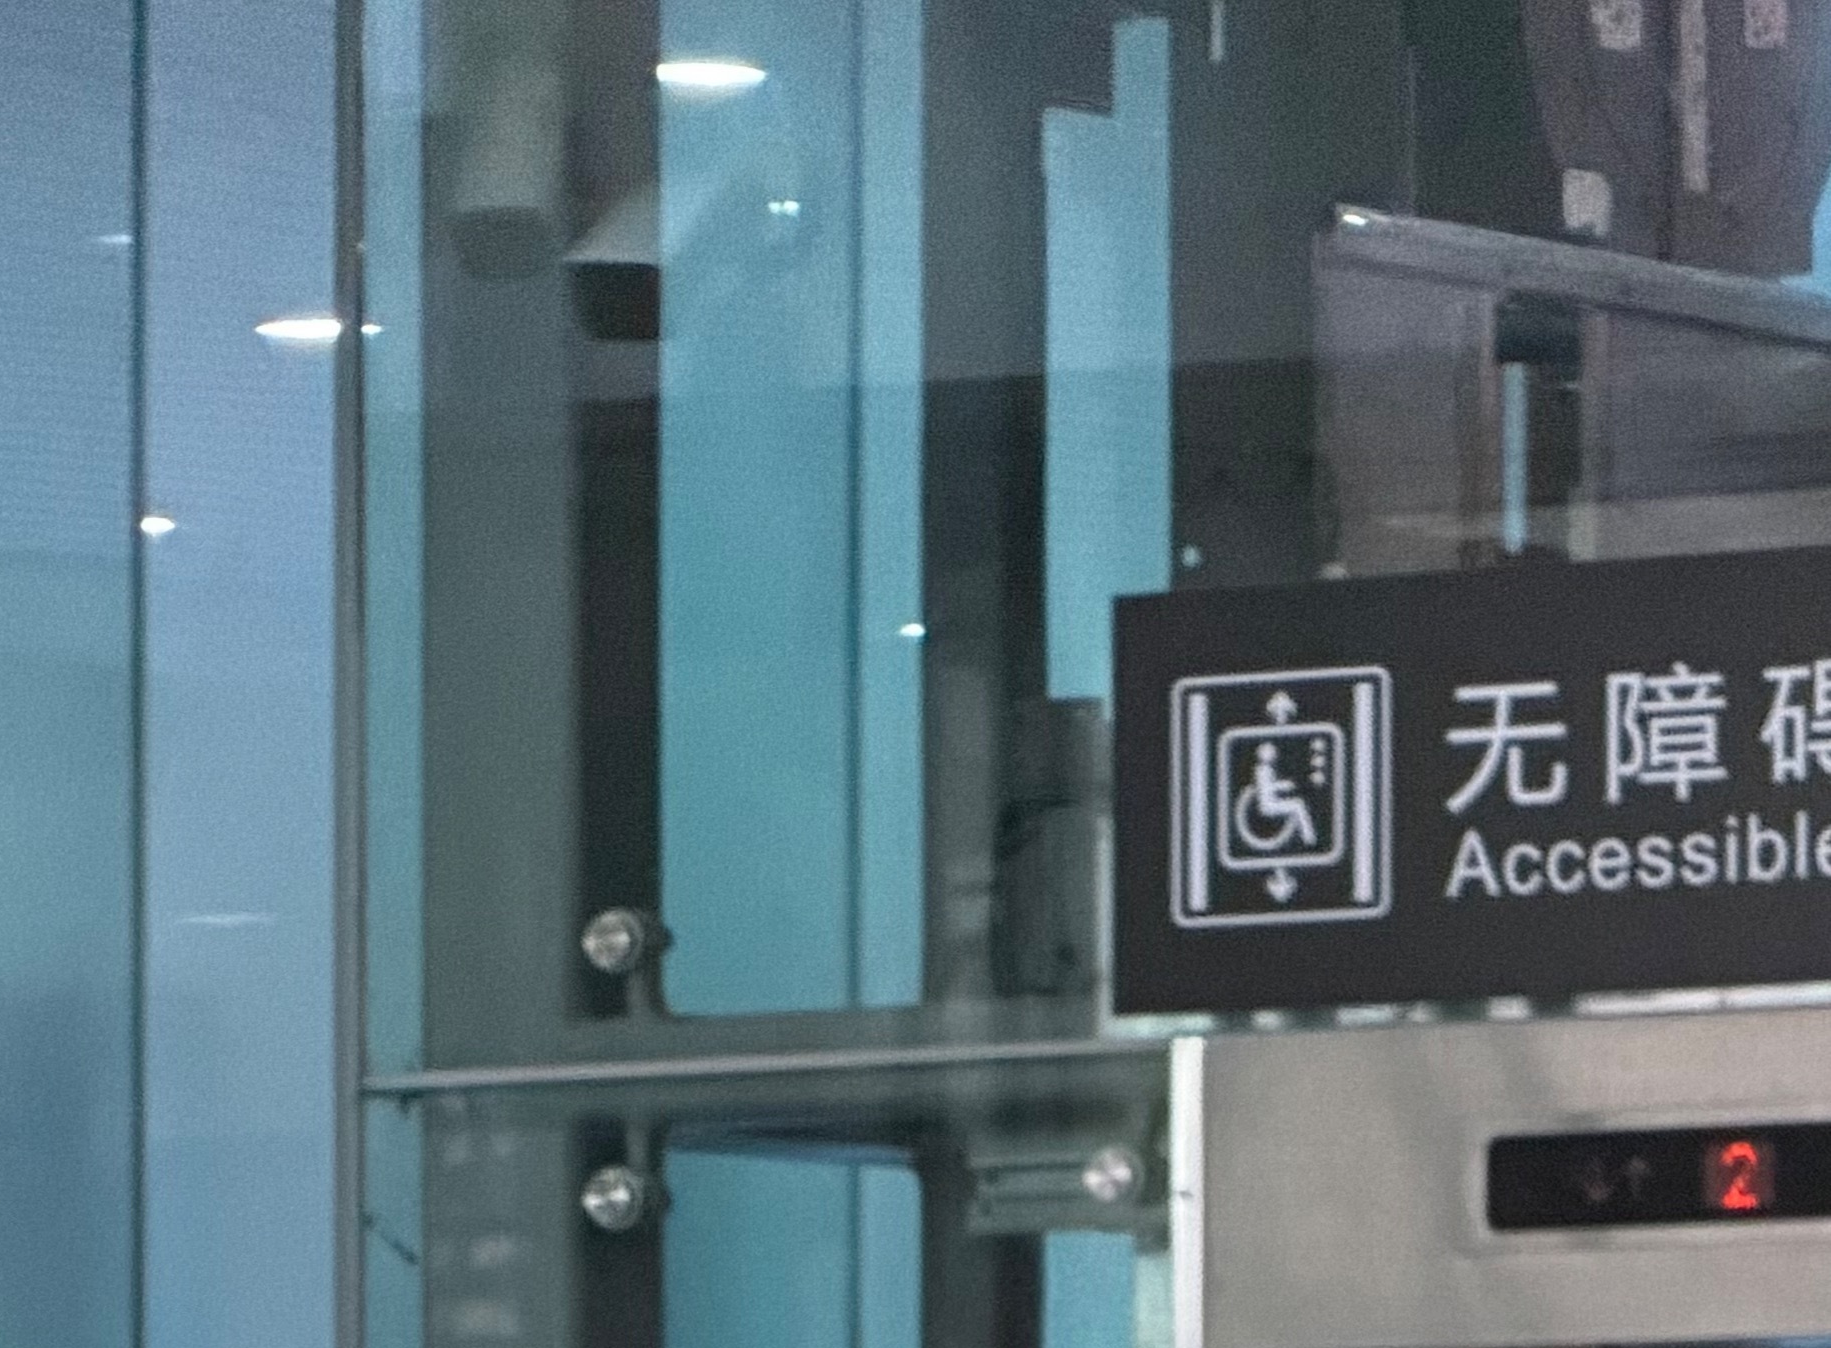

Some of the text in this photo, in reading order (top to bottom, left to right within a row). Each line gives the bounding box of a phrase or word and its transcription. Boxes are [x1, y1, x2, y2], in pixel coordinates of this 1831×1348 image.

[1445, 659, 1831, 815] 无障碍
[1721, 1140, 1758, 1210] 2
